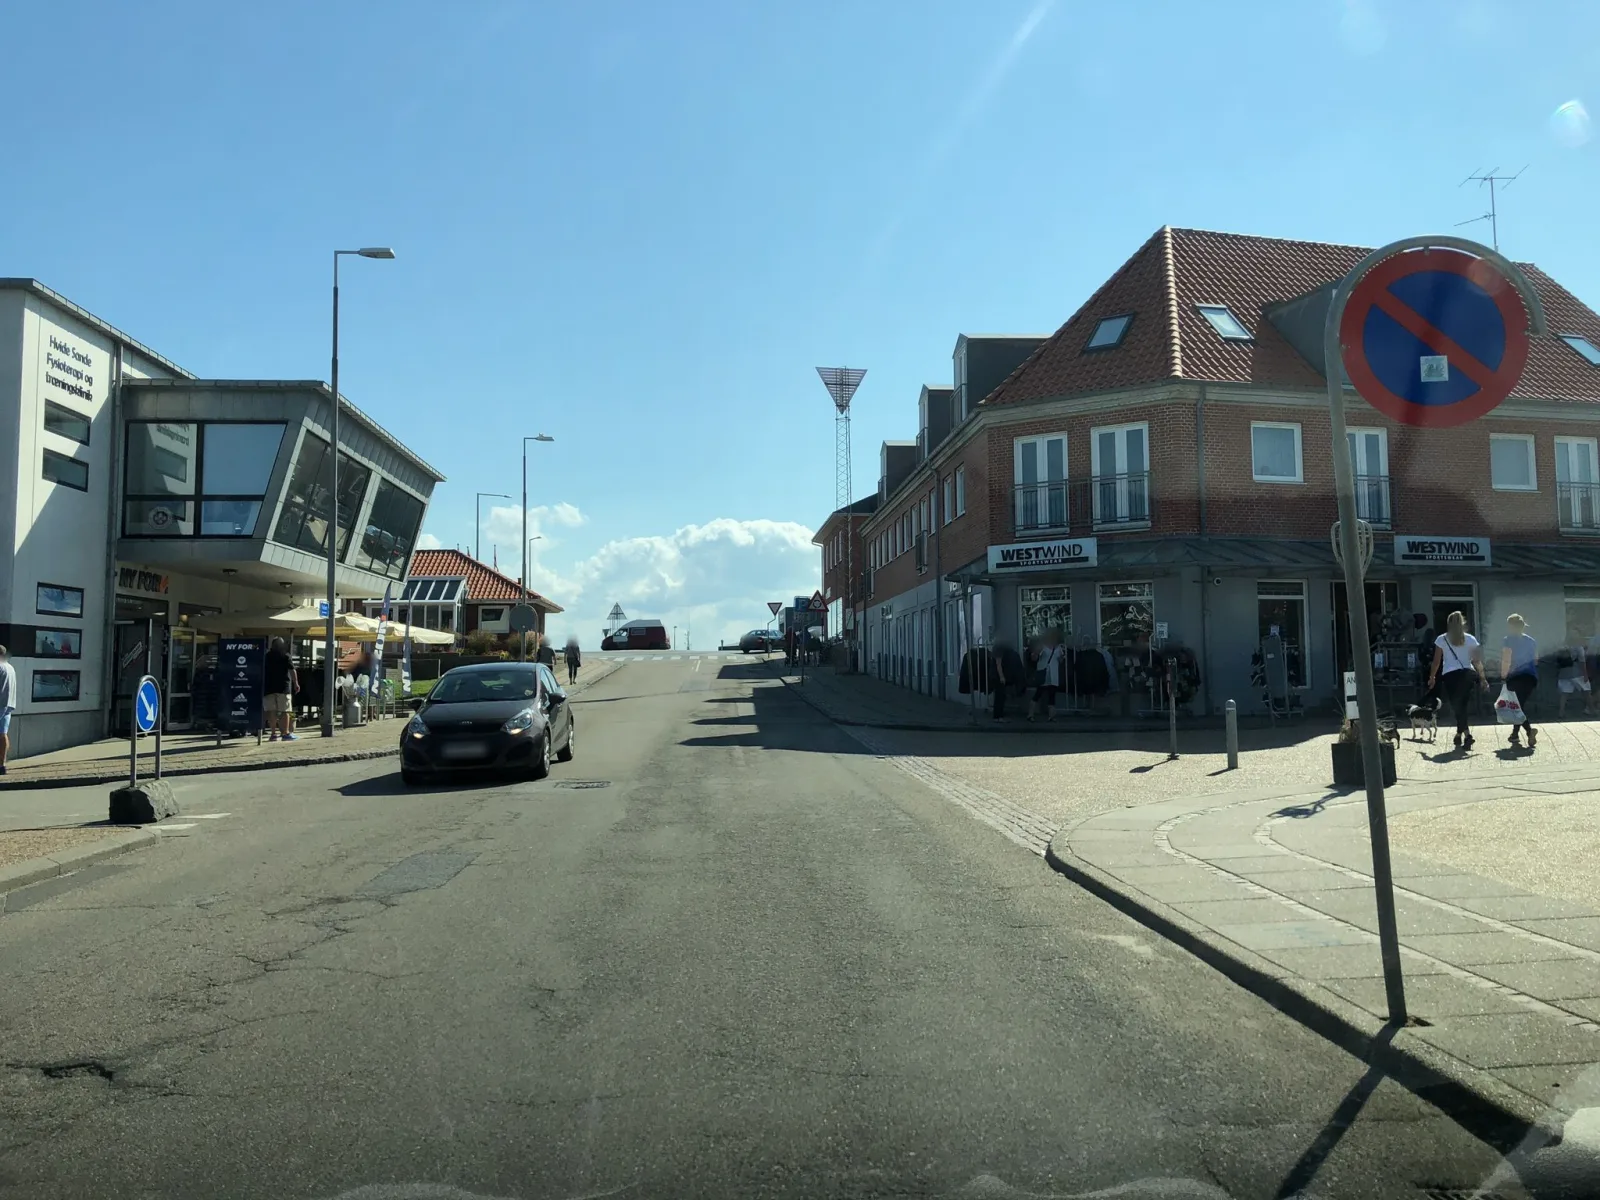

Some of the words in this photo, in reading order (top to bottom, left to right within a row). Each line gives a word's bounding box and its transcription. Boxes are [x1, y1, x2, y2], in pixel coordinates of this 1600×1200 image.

[49, 335, 70, 356] Hvide
[71, 347, 92, 367] Sande
[46, 352, 83, 381] Fysioterapi
[84, 374, 93, 387] og
[1001, 543, 1083, 562] WESTWIND
[1406, 541, 1480, 555] WESTWIND
[1020, 559, 1062, 567] SPORTSWEAR
